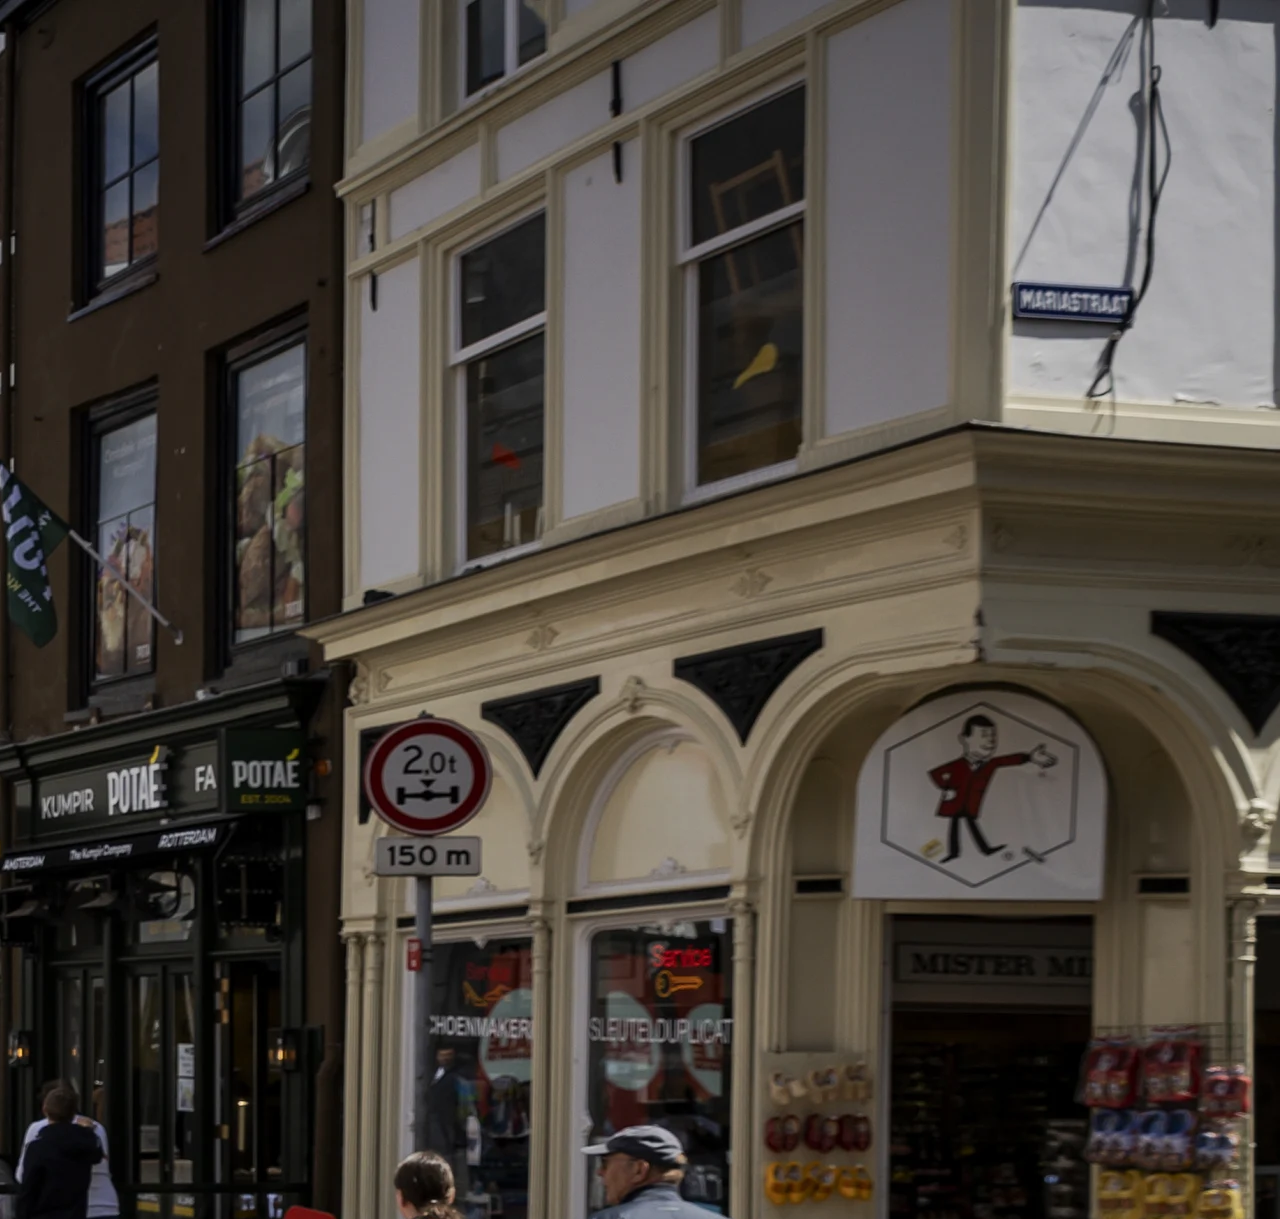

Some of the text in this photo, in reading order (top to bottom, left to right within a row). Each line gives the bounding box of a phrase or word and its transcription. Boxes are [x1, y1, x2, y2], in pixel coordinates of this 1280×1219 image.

[1020, 288, 1130, 315] MARIASTRAAT
[41, 788, 95, 819] KUMPIR
[158, 828, 217, 849] ROTTERDAM
[1, 855, 46, 871] AMSTERDAM
[387, 845, 470, 866] 150 m
[912, 953, 1035, 976] MISTER
